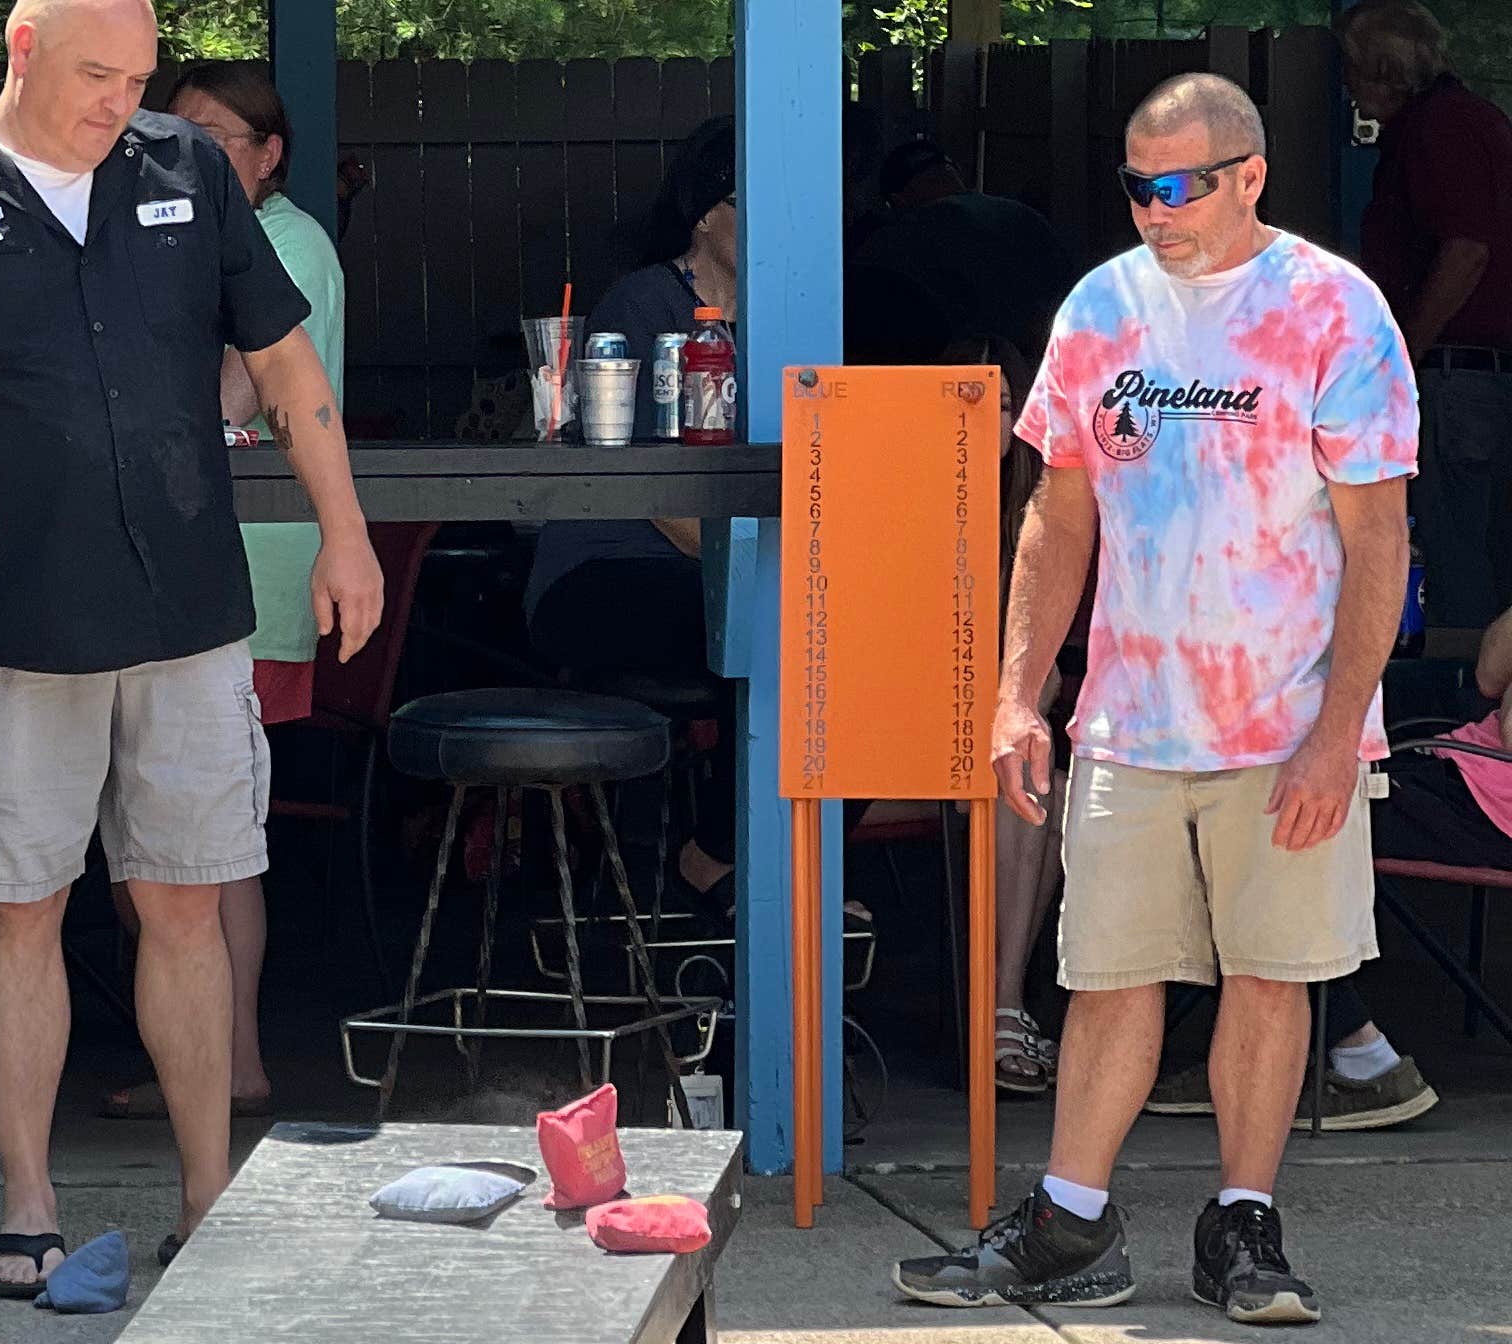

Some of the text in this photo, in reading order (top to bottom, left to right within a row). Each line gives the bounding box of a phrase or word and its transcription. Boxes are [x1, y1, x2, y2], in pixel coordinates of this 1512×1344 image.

[1102, 369, 1263, 413] Pineland
[810, 431, 821, 448] 2
[957, 430, 968, 446] 2
[810, 449, 821, 466] 3
[957, 448, 968, 465] 3
[809, 467, 821, 483] 4
[956, 466, 968, 483] 4
[810, 485, 821, 502] 5
[957, 484, 968, 501] 5
[809, 503, 821, 519] 6
[956, 502, 968, 519] 6
[809, 521, 821, 537] 7
[956, 521, 967, 536] 7
[809, 540, 821, 556] 8
[956, 538, 967, 555] 8
[809, 557, 821, 573] 9
[956, 556, 967, 573] 9
[806, 575, 828, 592] 10
[953, 575, 975, 590] 10
[806, 593, 825, 610] 11
[952, 593, 973, 610] 11
[806, 611, 828, 627] 12
[952, 611, 974, 627] 12
[806, 629, 827, 645] 13
[952, 628, 974, 645] 13
[806, 647, 827, 663] 14
[952, 646, 974, 662] 14
[806, 665, 827, 681] 15
[952, 665, 975, 682] 15
[805, 682, 827, 700] 16
[952, 683, 975, 701] 16
[805, 701, 825, 718] 17
[952, 701, 974, 718] 17
[805, 719, 826, 736] 18
[952, 719, 974, 736] 18
[804, 737, 826, 753] 19
[952, 737, 974, 754] 19
[803, 755, 826, 772] 20
[950, 756, 974, 772] 20
[803, 774, 824, 791] 21
[950, 774, 972, 791] 21
